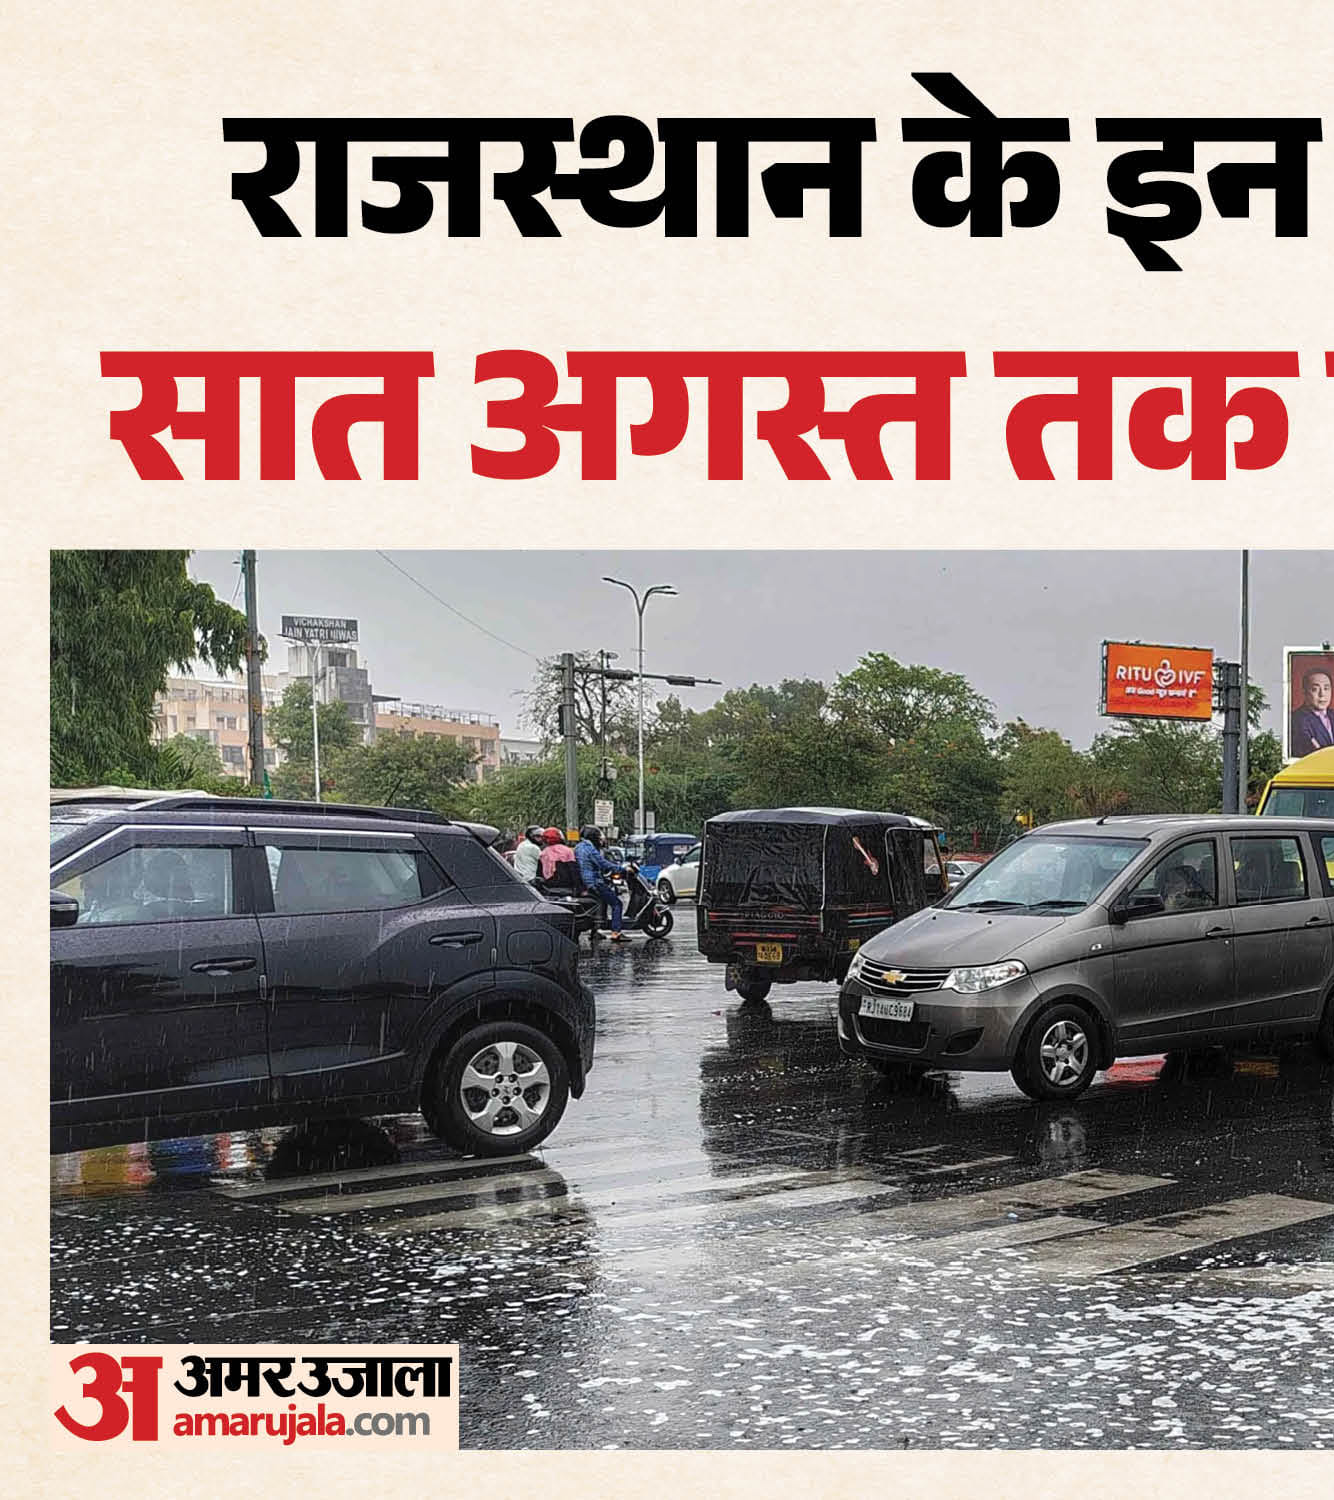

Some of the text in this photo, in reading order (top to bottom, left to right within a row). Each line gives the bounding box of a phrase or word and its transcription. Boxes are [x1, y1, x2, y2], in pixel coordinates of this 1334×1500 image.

[293, 618, 347, 629] VICHAKSHAN
[284, 626, 303, 638] JAIN
[304, 627, 328, 640] YATRI
[1115, 665, 1206, 684] RITU IVF
